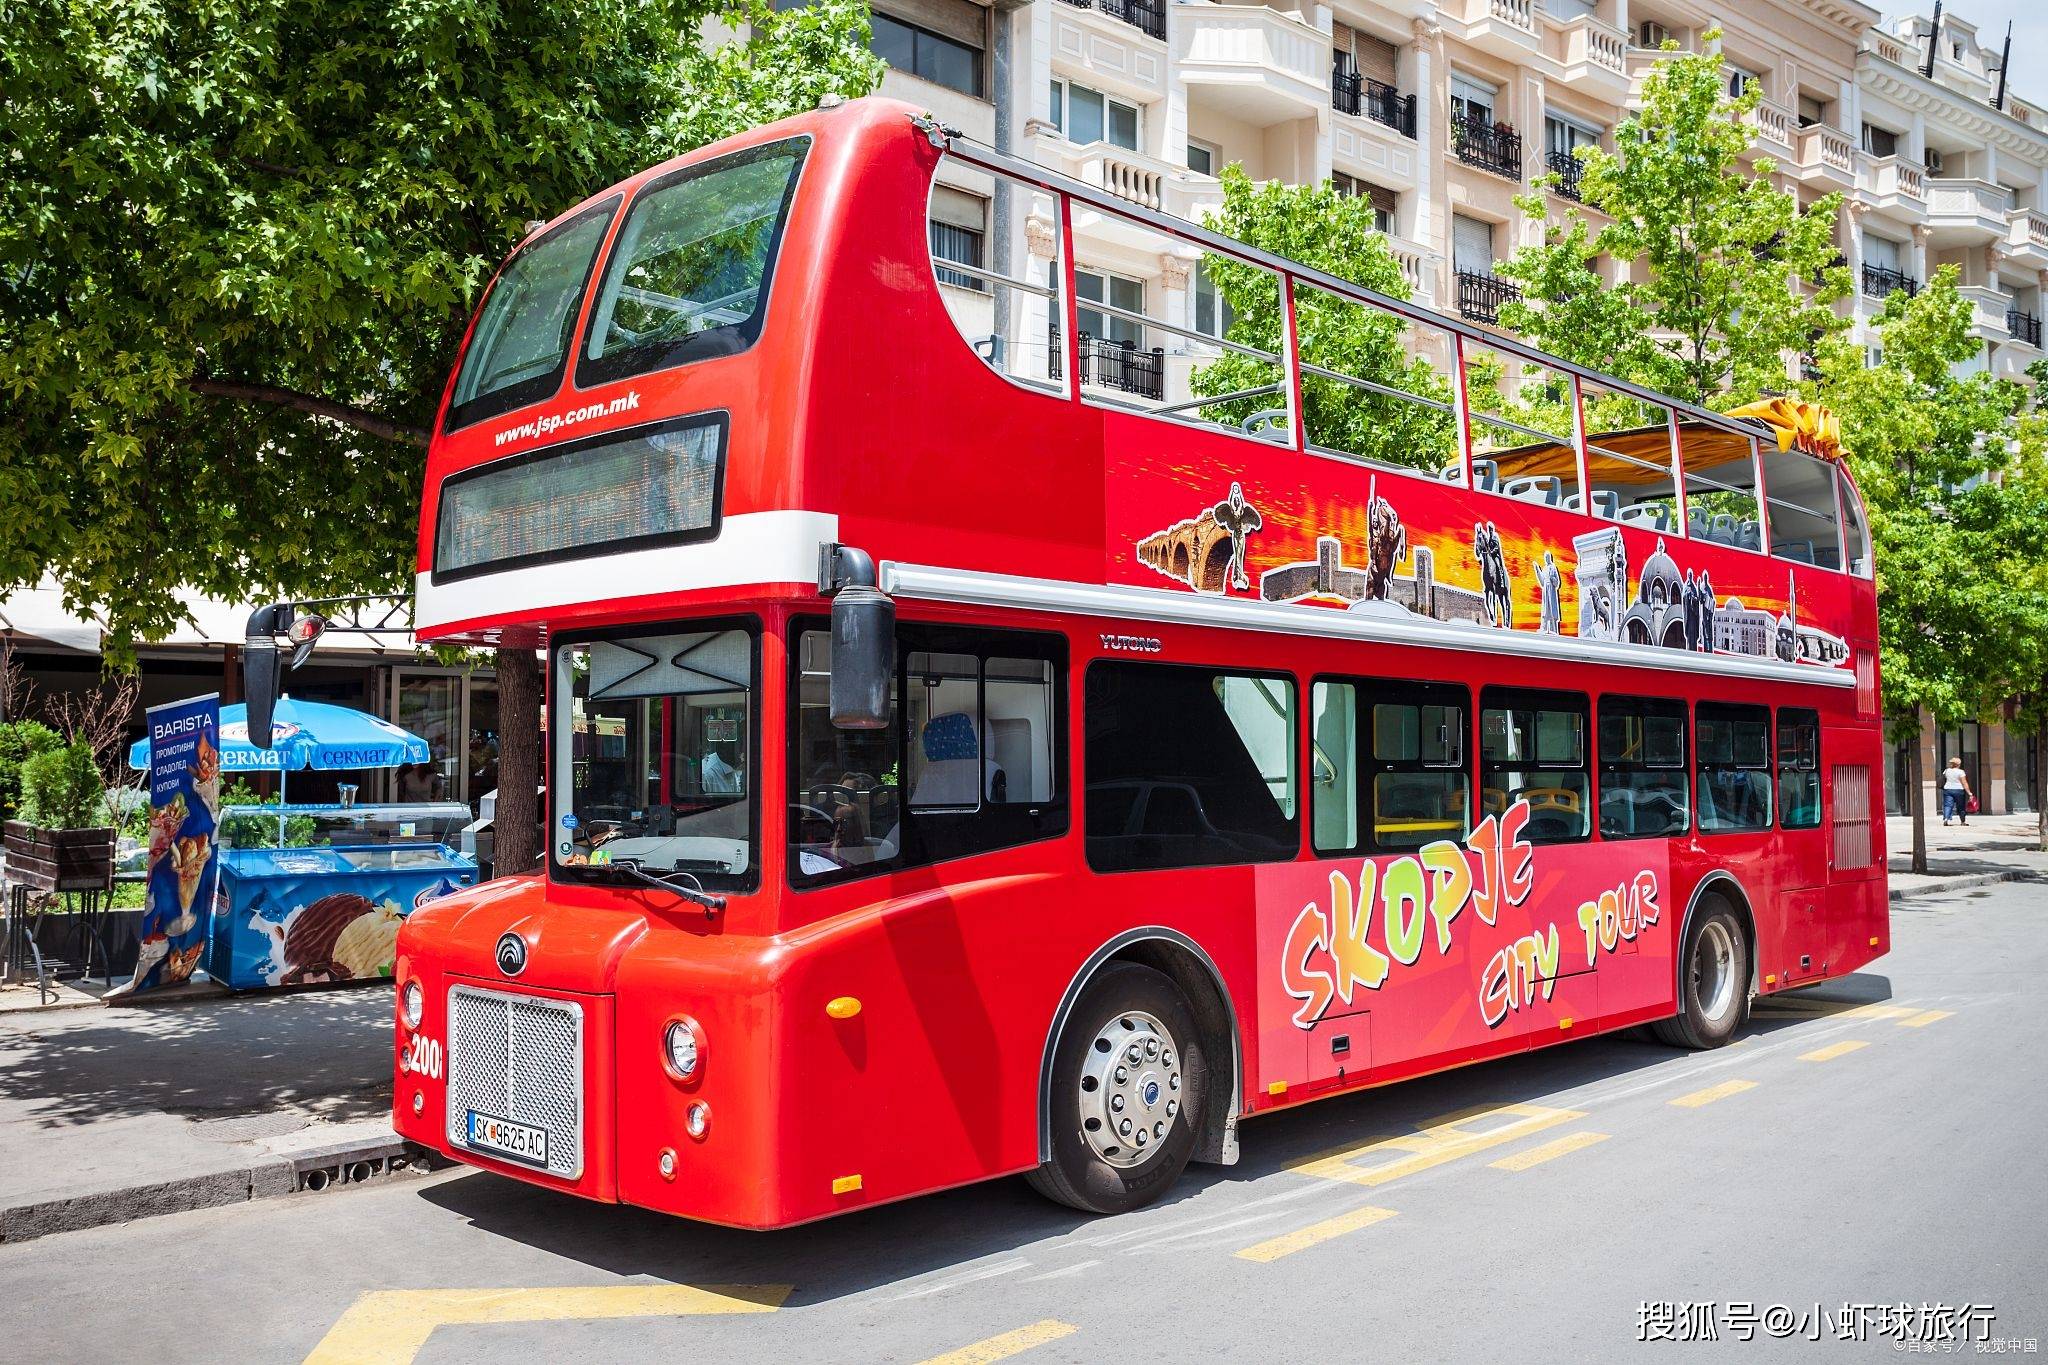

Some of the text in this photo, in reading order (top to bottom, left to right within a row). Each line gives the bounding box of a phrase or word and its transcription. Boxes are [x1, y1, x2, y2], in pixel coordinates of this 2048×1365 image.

[495, 391, 641, 447] www.jsp.com.mk
[1099, 634, 1161, 653] YUTONG
[154, 713, 213, 740] BARISTA
[155, 741, 195, 760] ПРОМОТИВНИ
[155, 760, 187, 777] СЛАДОЛЕД
[156, 778, 180, 794] КУПОВИ
[1281, 799, 1534, 1029] SKOPJE
[1479, 869, 1660, 1027] CITY TOUR
[476, 1117, 543, 1156] SK 9625 AC
